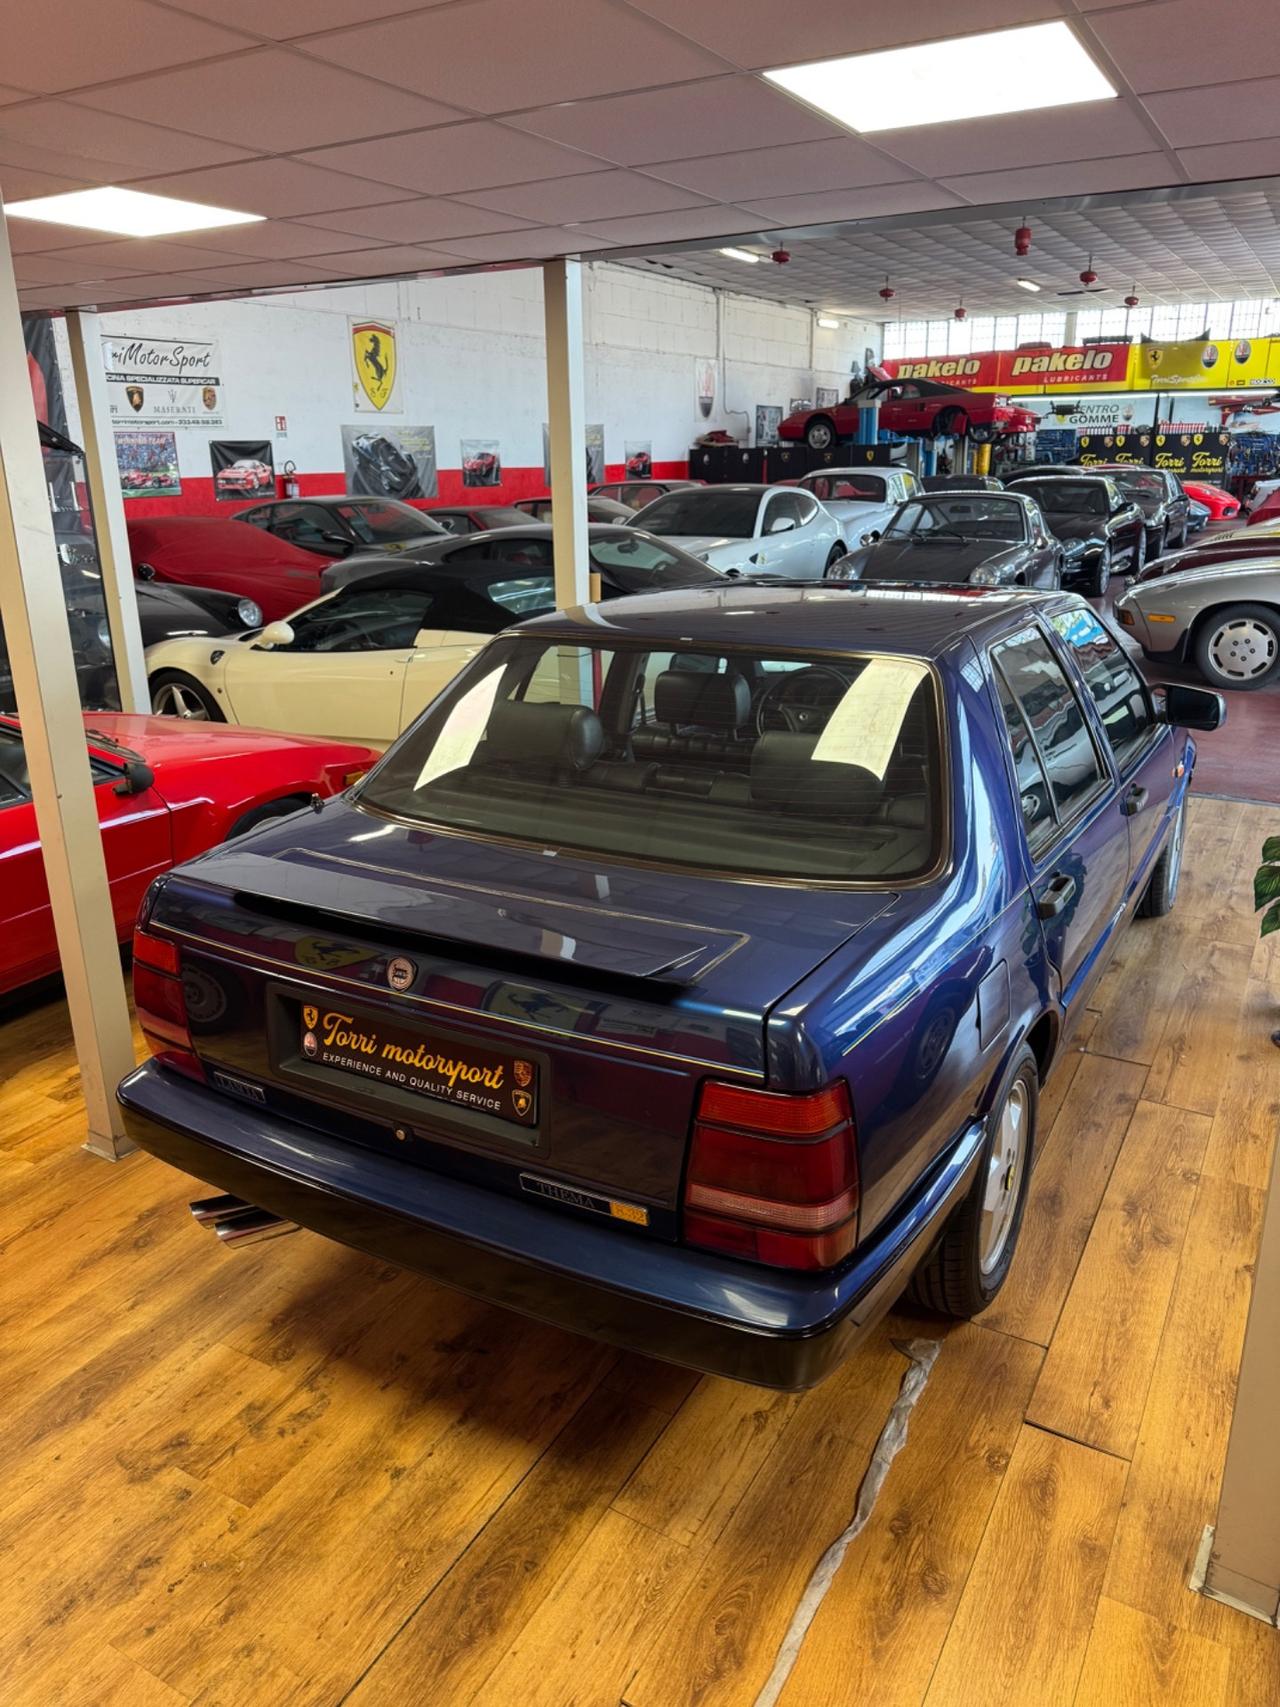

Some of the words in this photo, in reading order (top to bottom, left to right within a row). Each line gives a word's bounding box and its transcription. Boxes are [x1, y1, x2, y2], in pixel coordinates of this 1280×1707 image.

[898, 358, 980, 379] pakelo
[1011, 350, 1113, 376] pakelo
[1043, 373, 1108, 383] LUBRICANTS
[153, 405, 196, 414] MASERATI
[1080, 404, 1120, 413] ENTRO
[1069, 414, 1119, 425] GOMME
[1155, 452, 1185, 468] Torri
[1192, 451, 1223, 468] Torri
[322, 1011, 378, 1055] Torri
[381, 1042, 504, 1090] motorsport
[322, 1051, 382, 1076] EXPERIENCE
[385, 1069, 406, 1083] AND
[409, 1076, 453, 1097] QUALITY
[456, 1090, 501, 1111] SERVICE
[537, 1182, 597, 1209] THEMA
